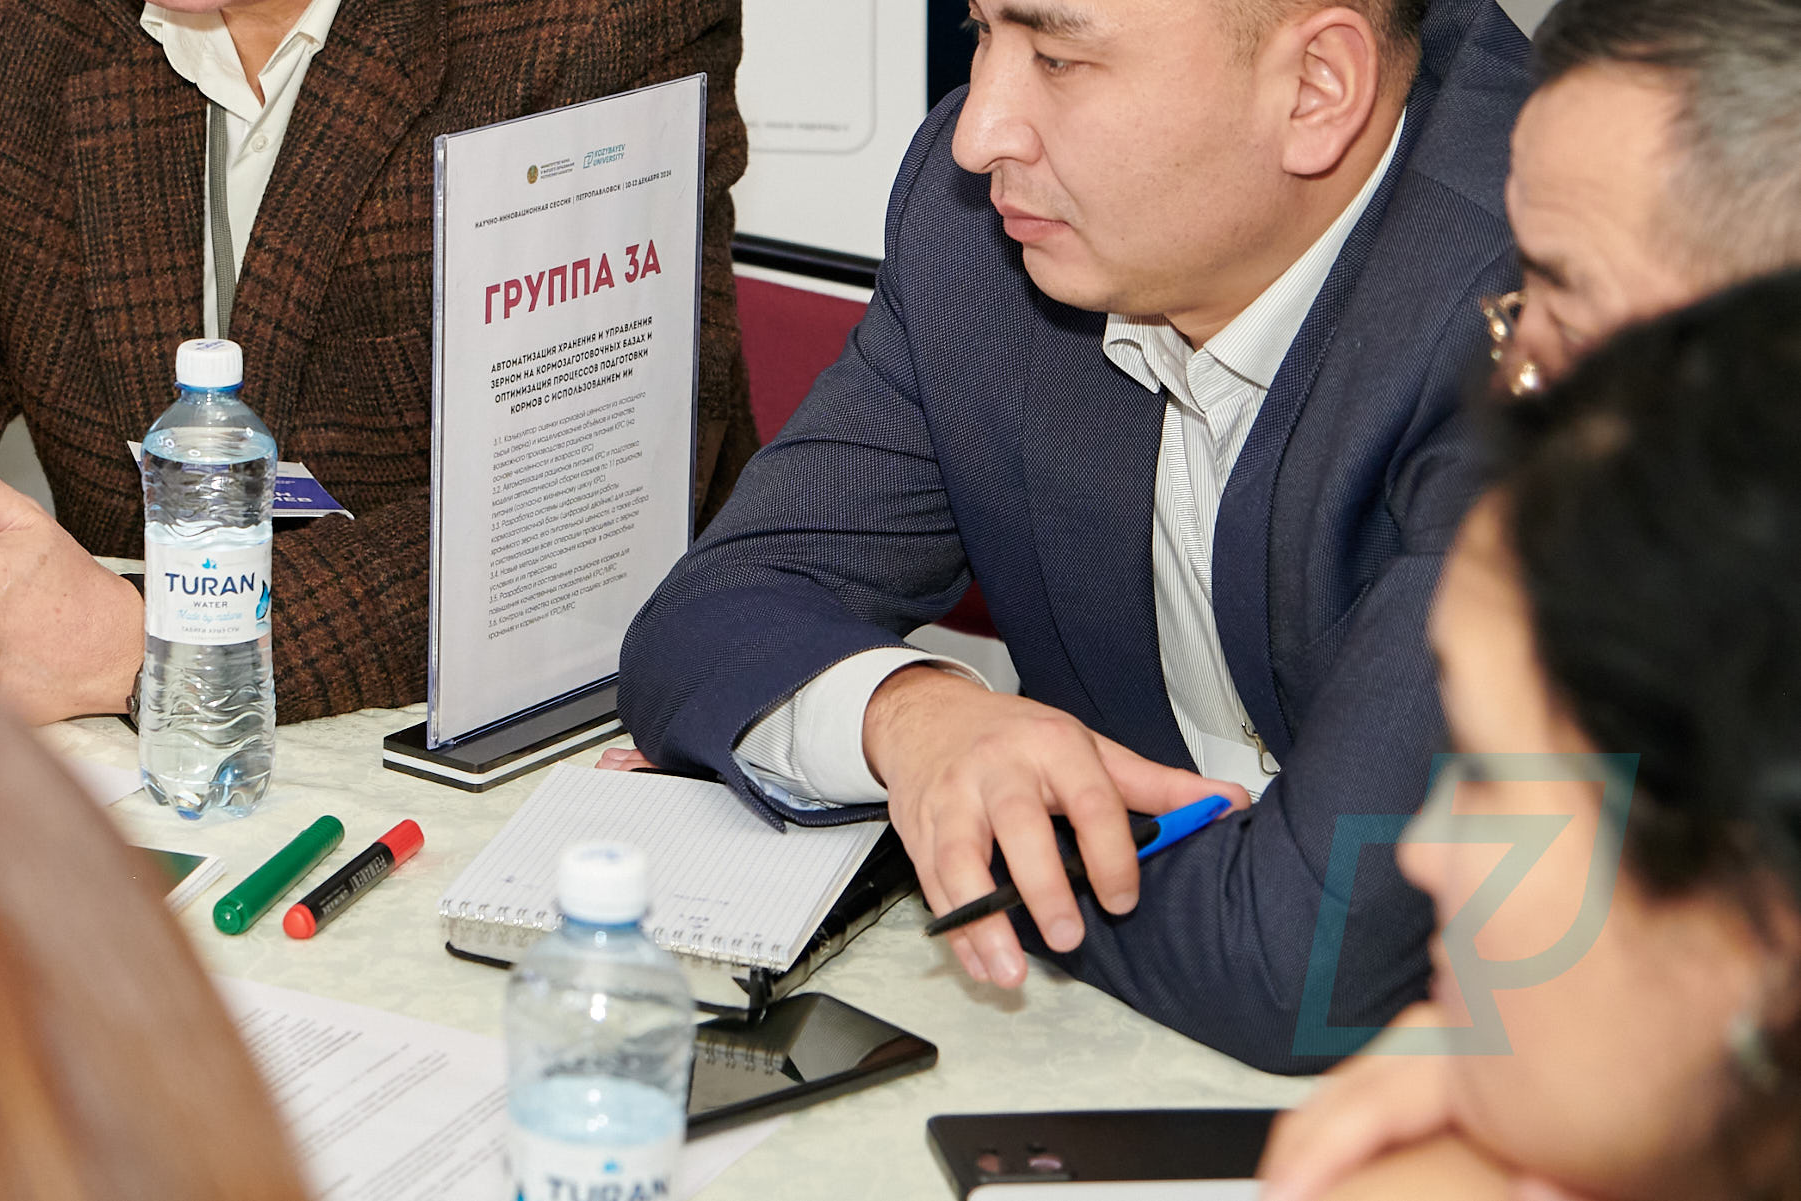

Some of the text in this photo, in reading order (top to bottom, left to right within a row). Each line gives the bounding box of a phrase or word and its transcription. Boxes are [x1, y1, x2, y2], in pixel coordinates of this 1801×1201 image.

[475, 203, 548, 228] НАУЧНО-ИННОВАЦИОННАЯ
[549, 197, 571, 209] СЕССИЯ
[575, 184, 620, 200] ПЕТРОПАВЛОВСК
[485, 255, 614, 323] ГРУППА
[491, 316, 652, 372] АВТОМАТИЗАЦИЯ ХРАНЕНИЯ И УПРАВЛЕНИЯ
[491, 332, 652, 389] ЗЕРНОМ НА КОРМОЗАГОТОВОЧНЫХ БАЗАХ И
[494, 349, 648, 403] ОПТИМИЗАЦИЯ ПРОЦЕССОВ ПОДГОТОВКИ
[510, 368, 633, 414] КОРМОВ С ИСПОЛЬЗОВАНИЕМ ИИ
[165, 572, 255, 597] TURAN
[193, 601, 228, 609] WATER
